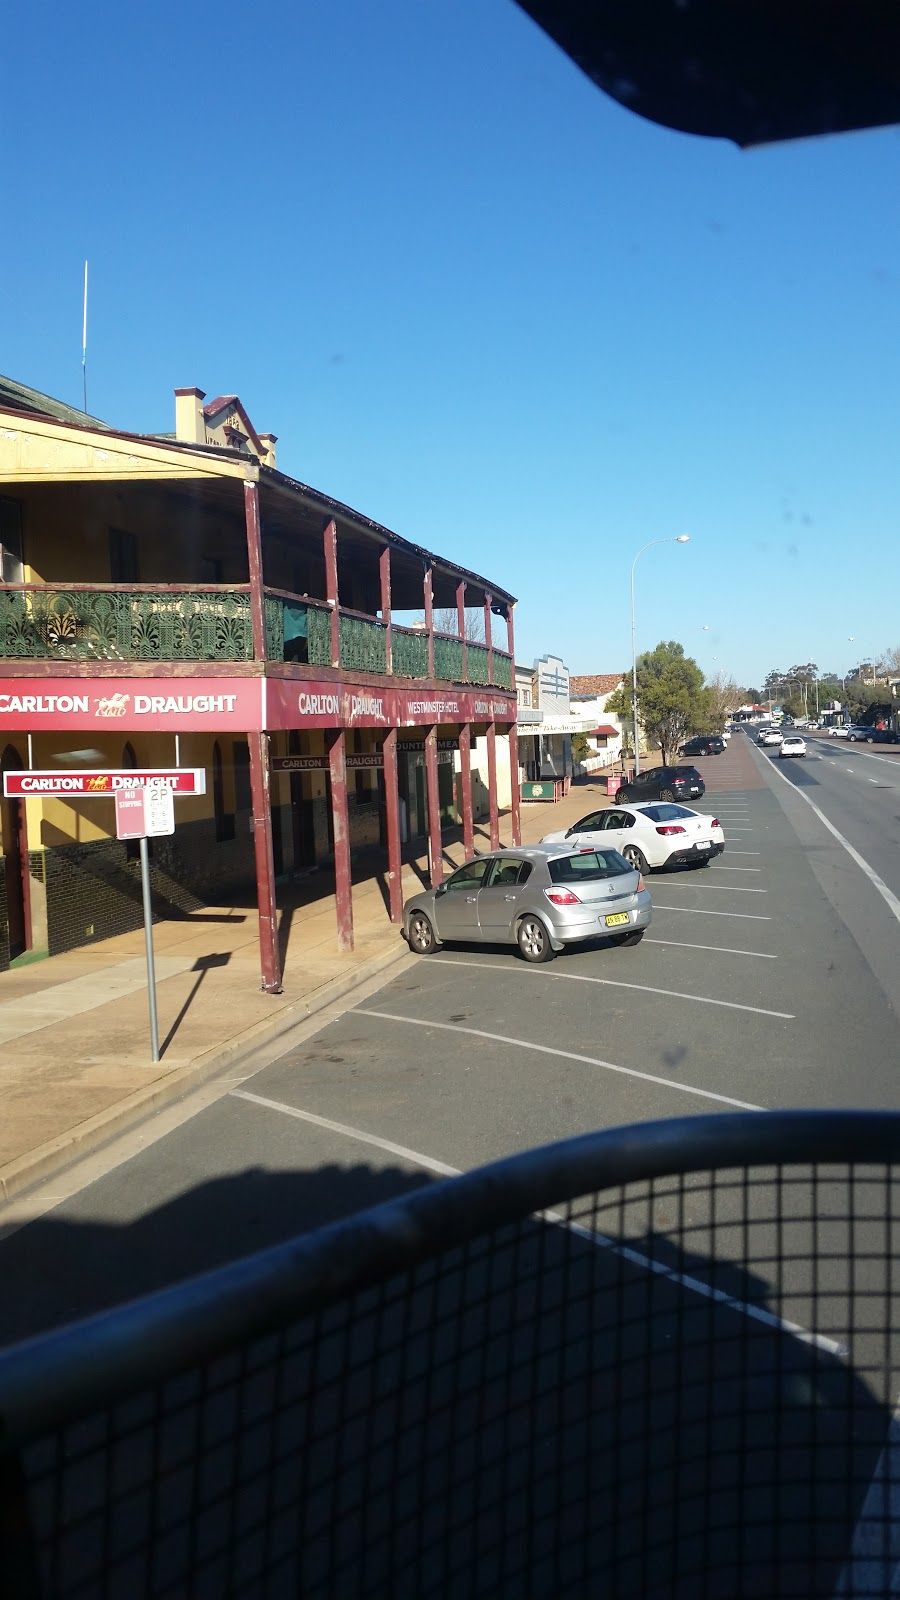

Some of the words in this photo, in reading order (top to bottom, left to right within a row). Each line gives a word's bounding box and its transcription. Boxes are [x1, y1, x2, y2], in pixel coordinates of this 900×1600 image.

[0, 695, 89, 713] CARLTON
[134, 695, 237, 713] DRAUGHT
[298, 692, 339, 715] CARLTON
[351, 695, 383, 715] DRAUGHT
[408, 701, 445, 714] WESTMINSTER
[282, 760, 322, 768] CARLTON
[346, 757, 383, 766] RAUGHT
[21, 777, 84, 791] CARLTON
[112, 776, 180, 790] DRAUGHT
[125, 790, 136, 799] NO
[150, 788, 168, 801] 2P
